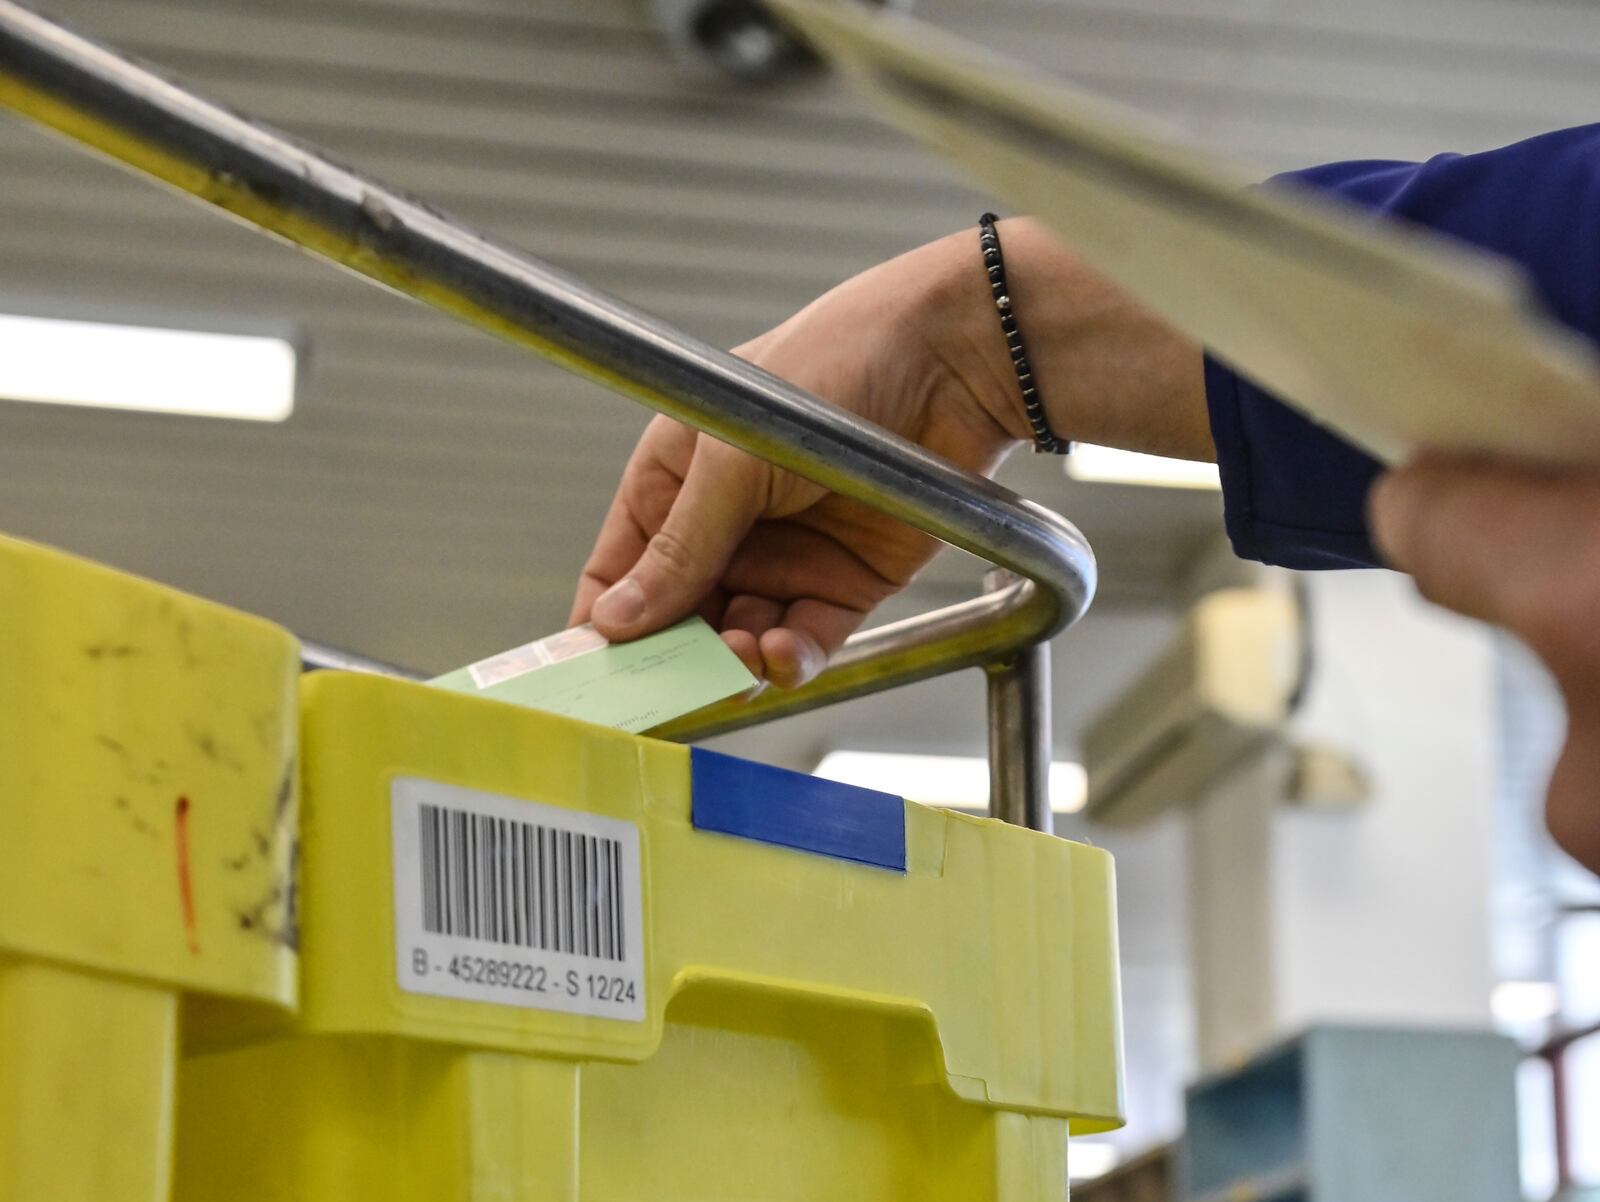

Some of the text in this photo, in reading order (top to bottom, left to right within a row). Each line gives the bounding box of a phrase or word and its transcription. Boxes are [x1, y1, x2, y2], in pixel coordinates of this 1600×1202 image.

[412, 947, 429, 976] B
[448, 955, 548, 992] 45289222
[566, 970, 581, 997] S
[587, 974, 636, 1004] 12/24
